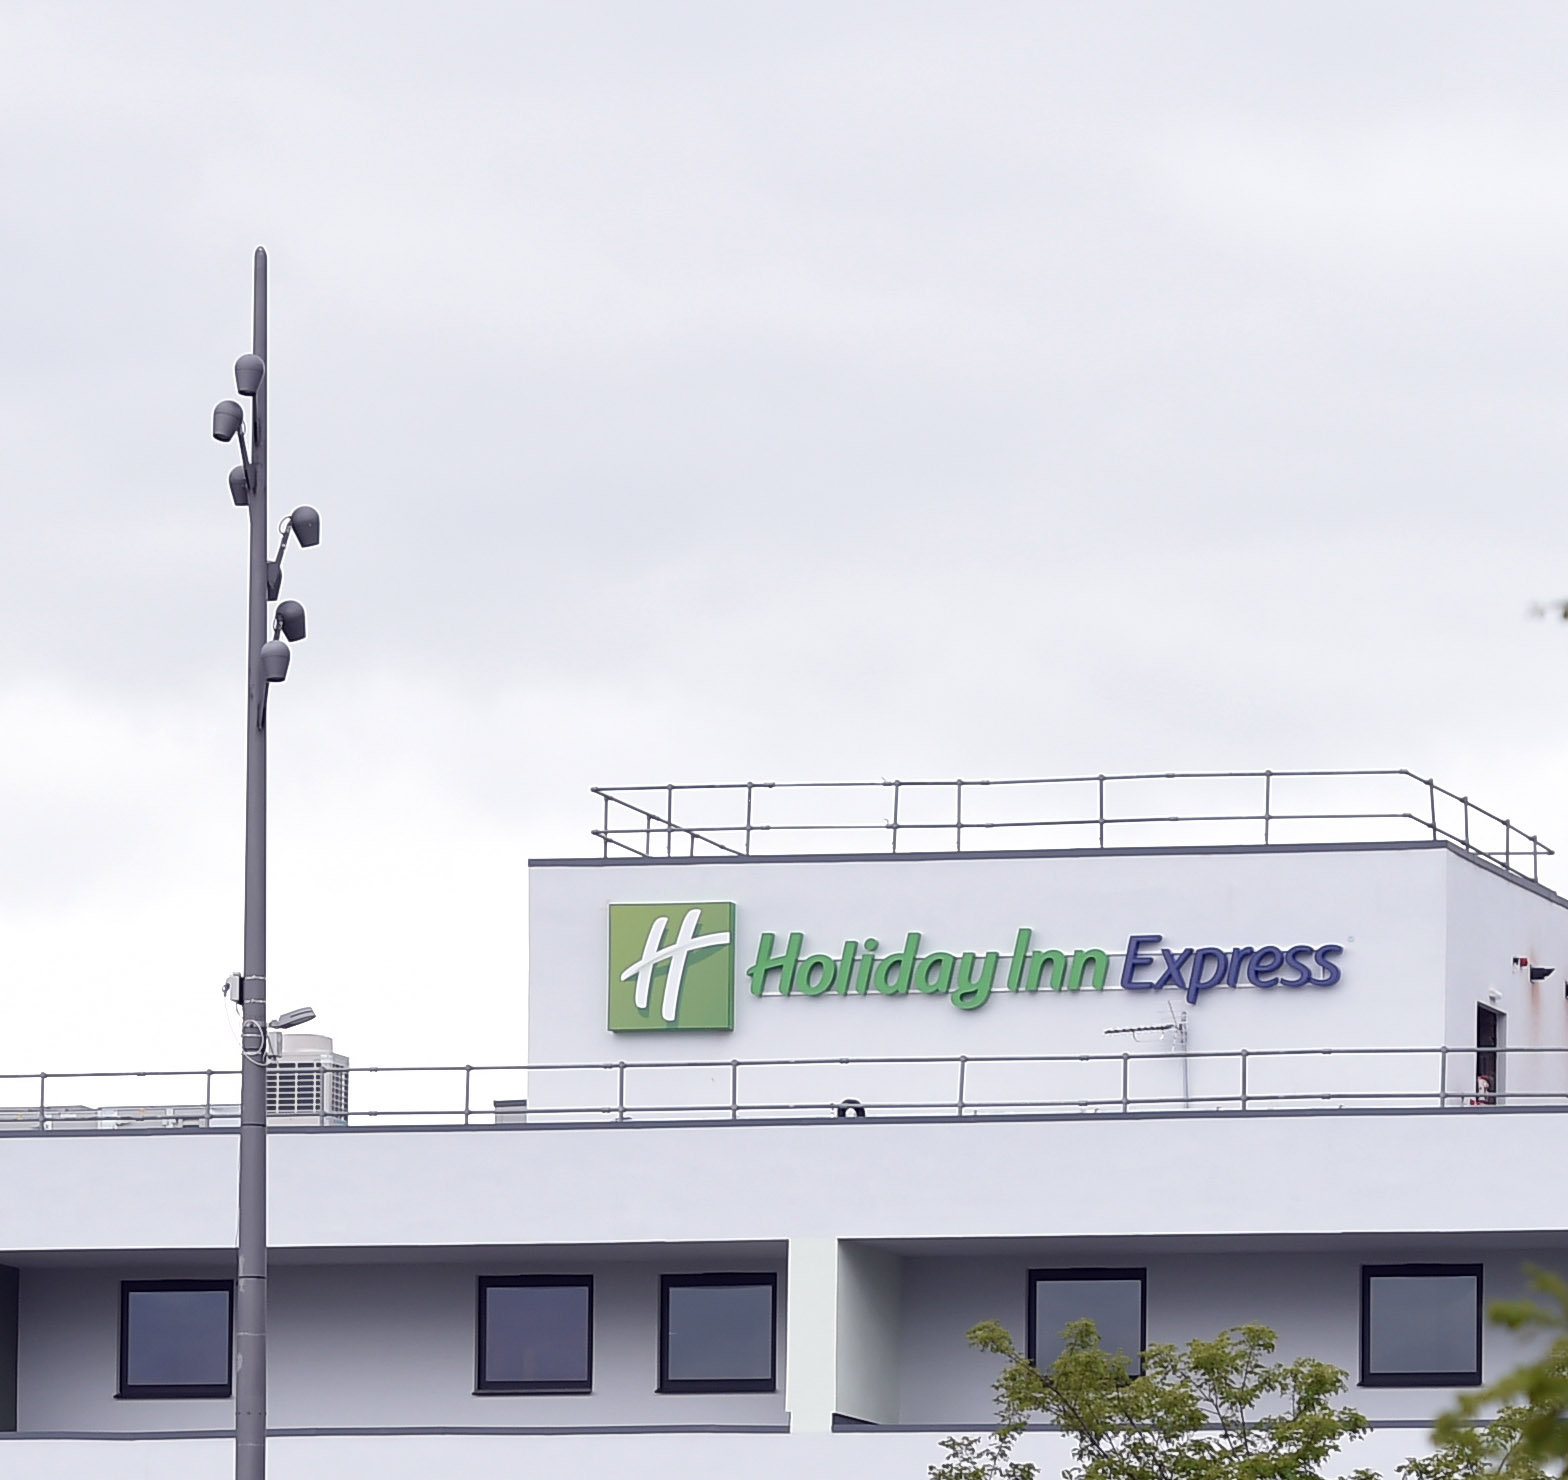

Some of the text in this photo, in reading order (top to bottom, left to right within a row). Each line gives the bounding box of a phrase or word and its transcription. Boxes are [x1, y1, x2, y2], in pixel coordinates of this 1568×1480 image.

[747, 928, 1343, 1010] Holiday Inn Express
